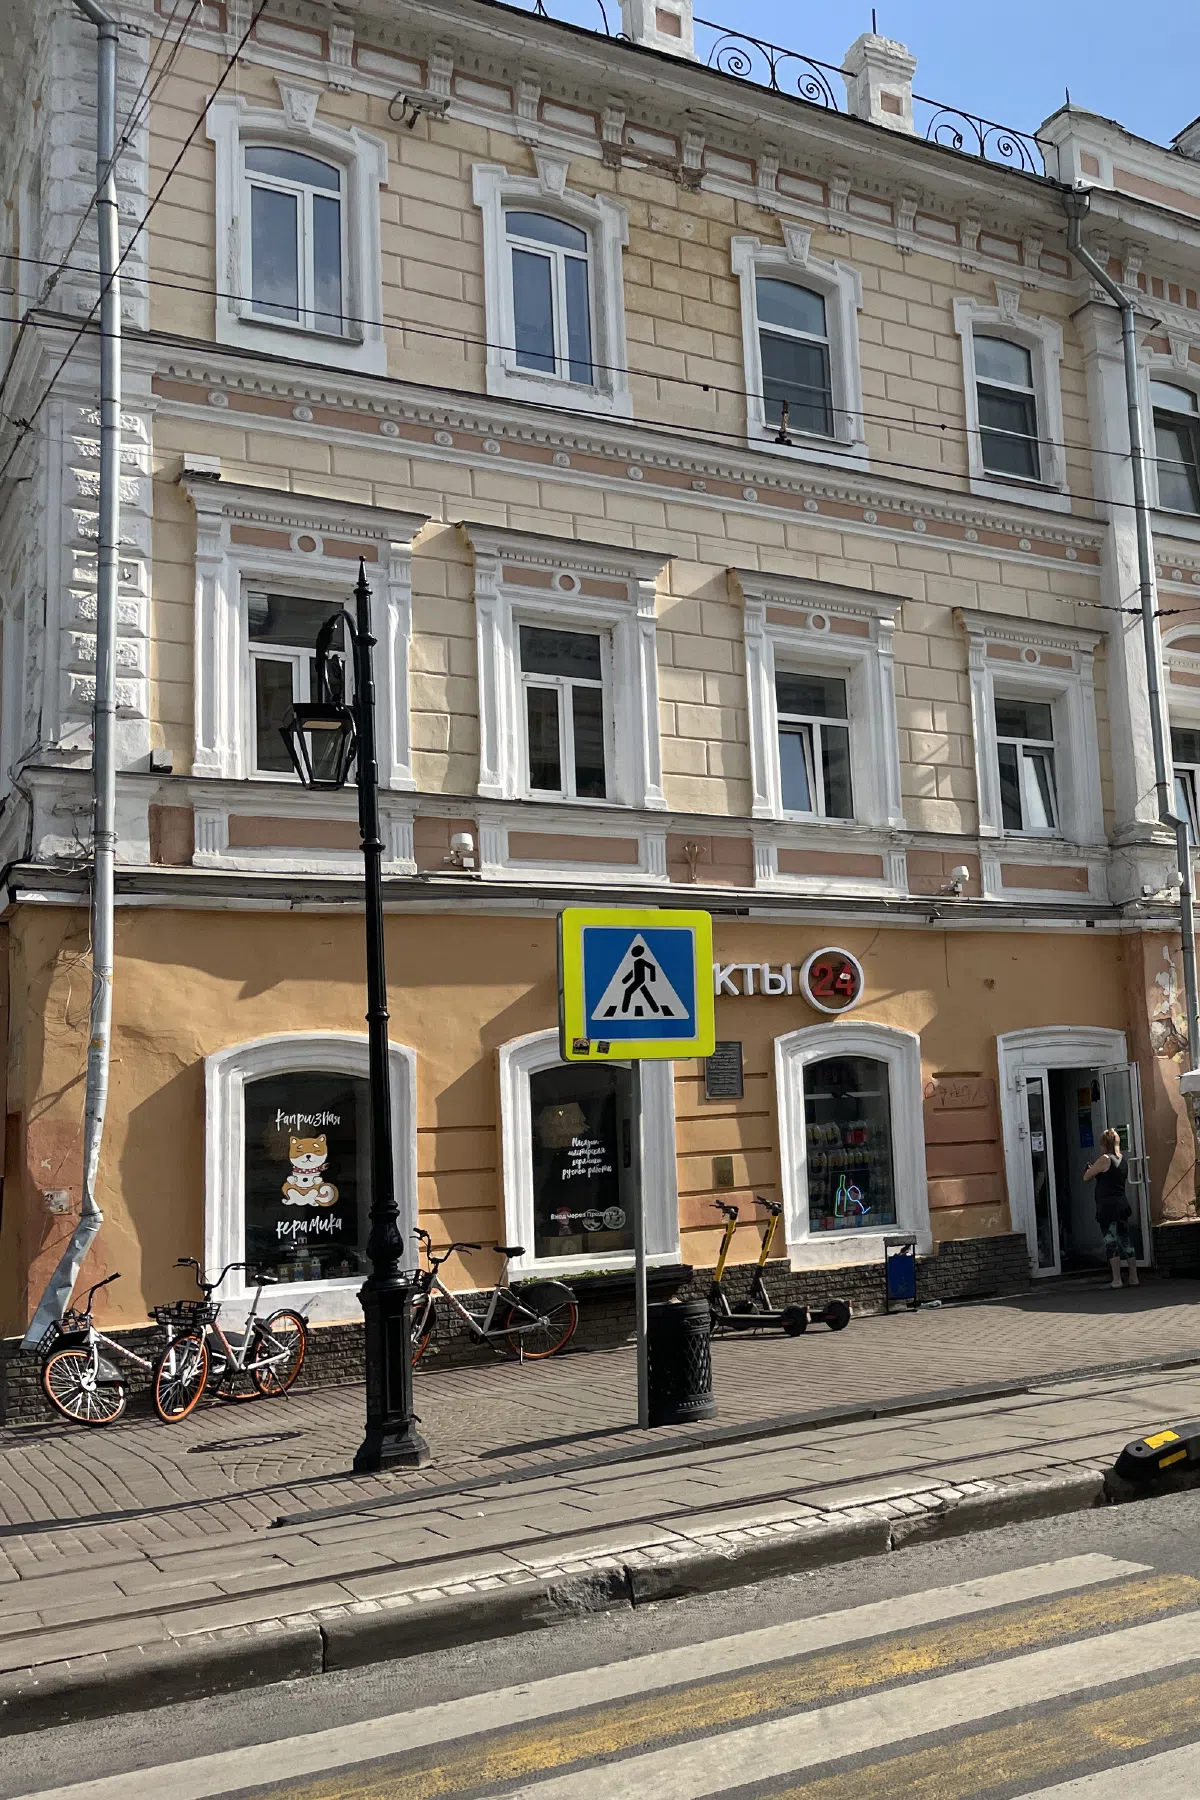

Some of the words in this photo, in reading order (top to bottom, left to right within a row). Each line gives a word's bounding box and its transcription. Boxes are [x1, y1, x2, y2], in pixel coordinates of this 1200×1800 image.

[713, 963, 793, 996] КТЫ
[811, 963, 857, 997] 24
[275, 1108, 341, 1131] Капризная
[275, 1213, 342, 1239] керамика
